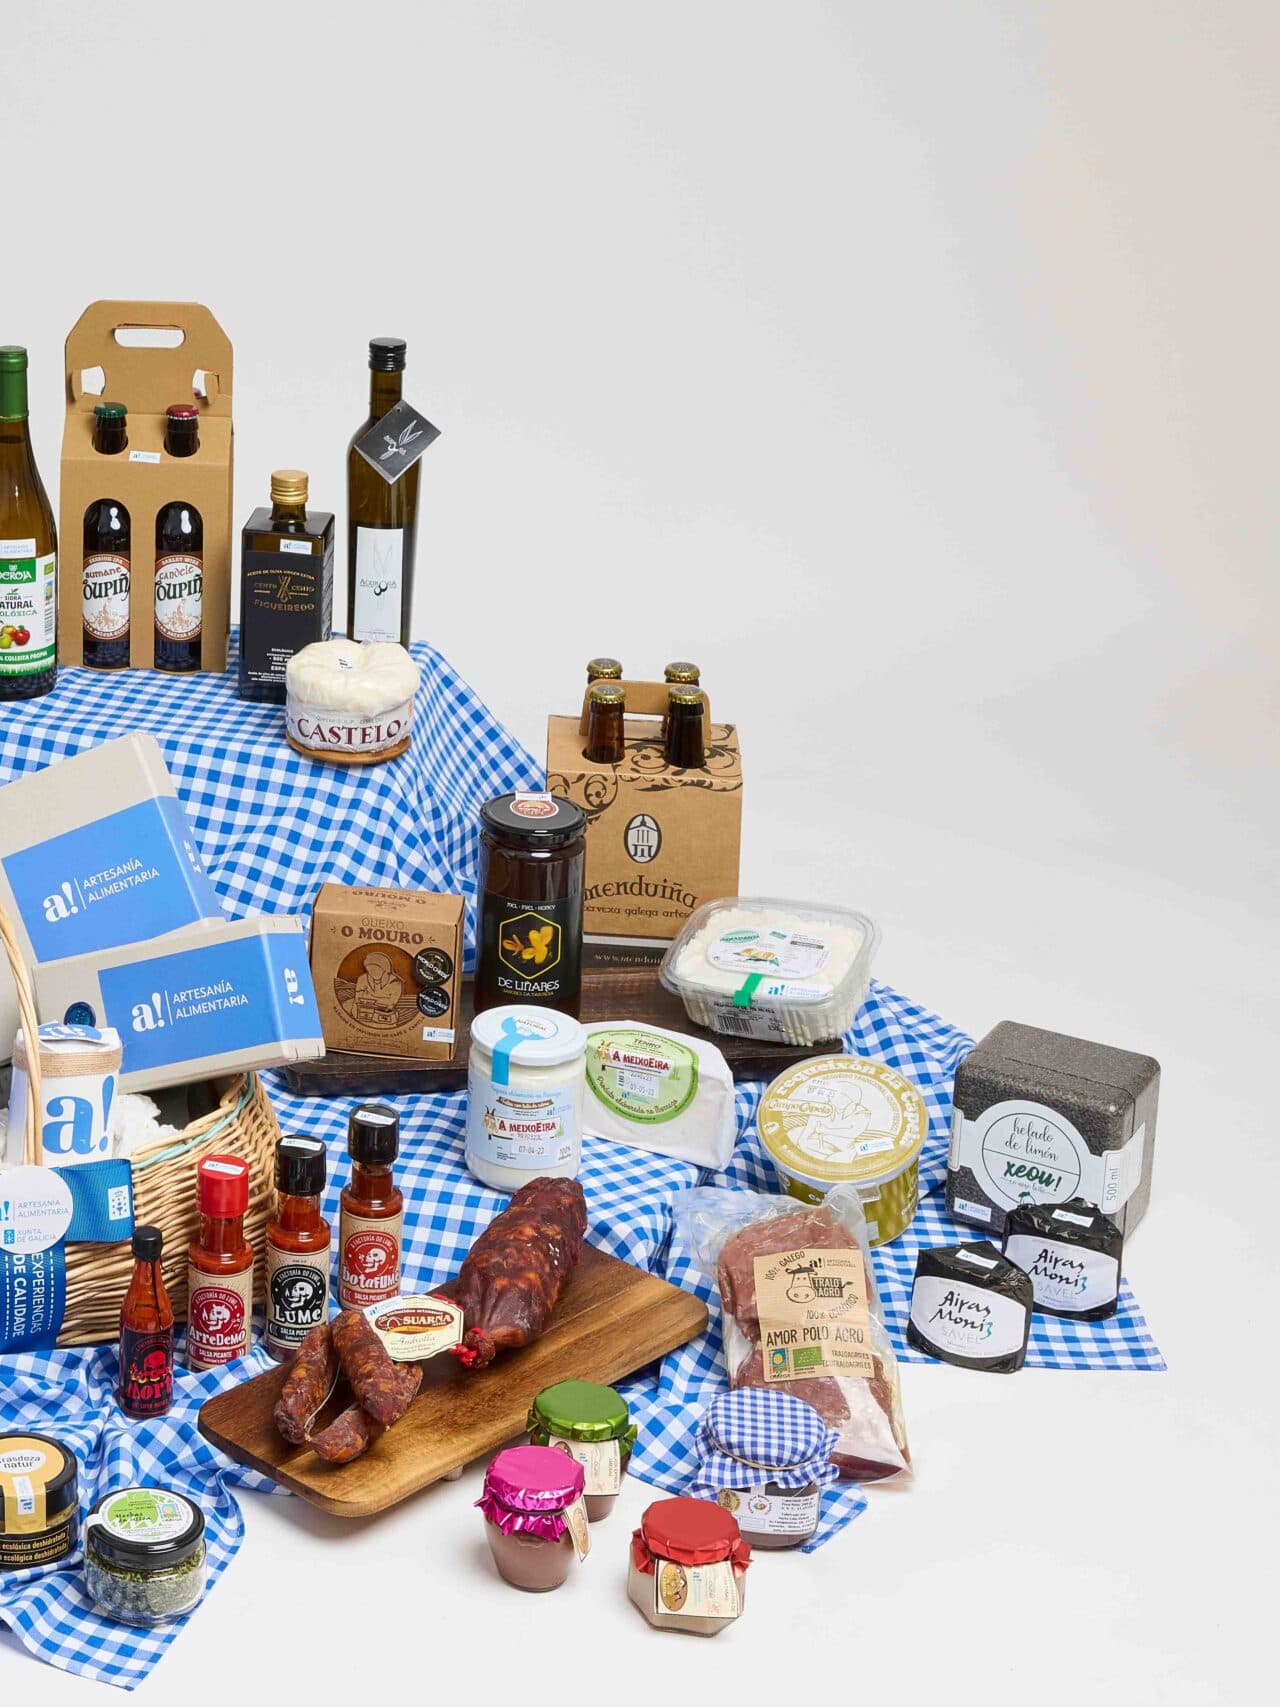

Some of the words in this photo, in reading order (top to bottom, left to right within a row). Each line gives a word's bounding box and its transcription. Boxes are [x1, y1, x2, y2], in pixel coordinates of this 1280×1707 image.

[254, 599, 316, 612] FIGUEIREDO
[297, 717, 402, 746] CASTELO
[41, 881, 79, 923] a!
[82, 857, 144, 890] ARTESANÍA
[87, 867, 161, 904] ALIMENTARIA
[361, 917, 405, 931] QUEIXO
[341, 925, 354, 938] O
[358, 927, 424, 945] MOURO
[498, 977, 515, 990] DE
[768, 985, 786, 997] a!
[131, 992, 166, 1033] a!
[172, 980, 234, 1006] ARTESANÍA
[175, 993, 249, 1020] ALIMENTARIA
[613, 1050, 621, 1062] A
[42, 1074, 116, 1156] a!
[498, 1119, 507, 1132] A
[1013, 1117, 1054, 1142] helado
[1005, 1134, 1023, 1150] de
[1025, 1136, 1059, 1162] limón
[1004, 1160, 1062, 1192] xeou!
[17, 1207, 69, 1219] ALIMENTARIA
[16, 1229, 43, 1237] XUNTA
[16, 1235, 27, 1243] DE
[28, 1233, 58, 1242] GALICIA
[12, 1253, 26, 1275] DE
[779, 1250, 806, 1268] GALEGO
[30, 1252, 47, 1335] EXPERIENCIAS
[818, 1288, 841, 1297] AGRO
[12, 1276, 26, 1338] CALIDADE
[766, 1329, 798, 1347] AMOR
[803, 1326, 829, 1341] POLO
[835, 1328, 865, 1344] AGRO
